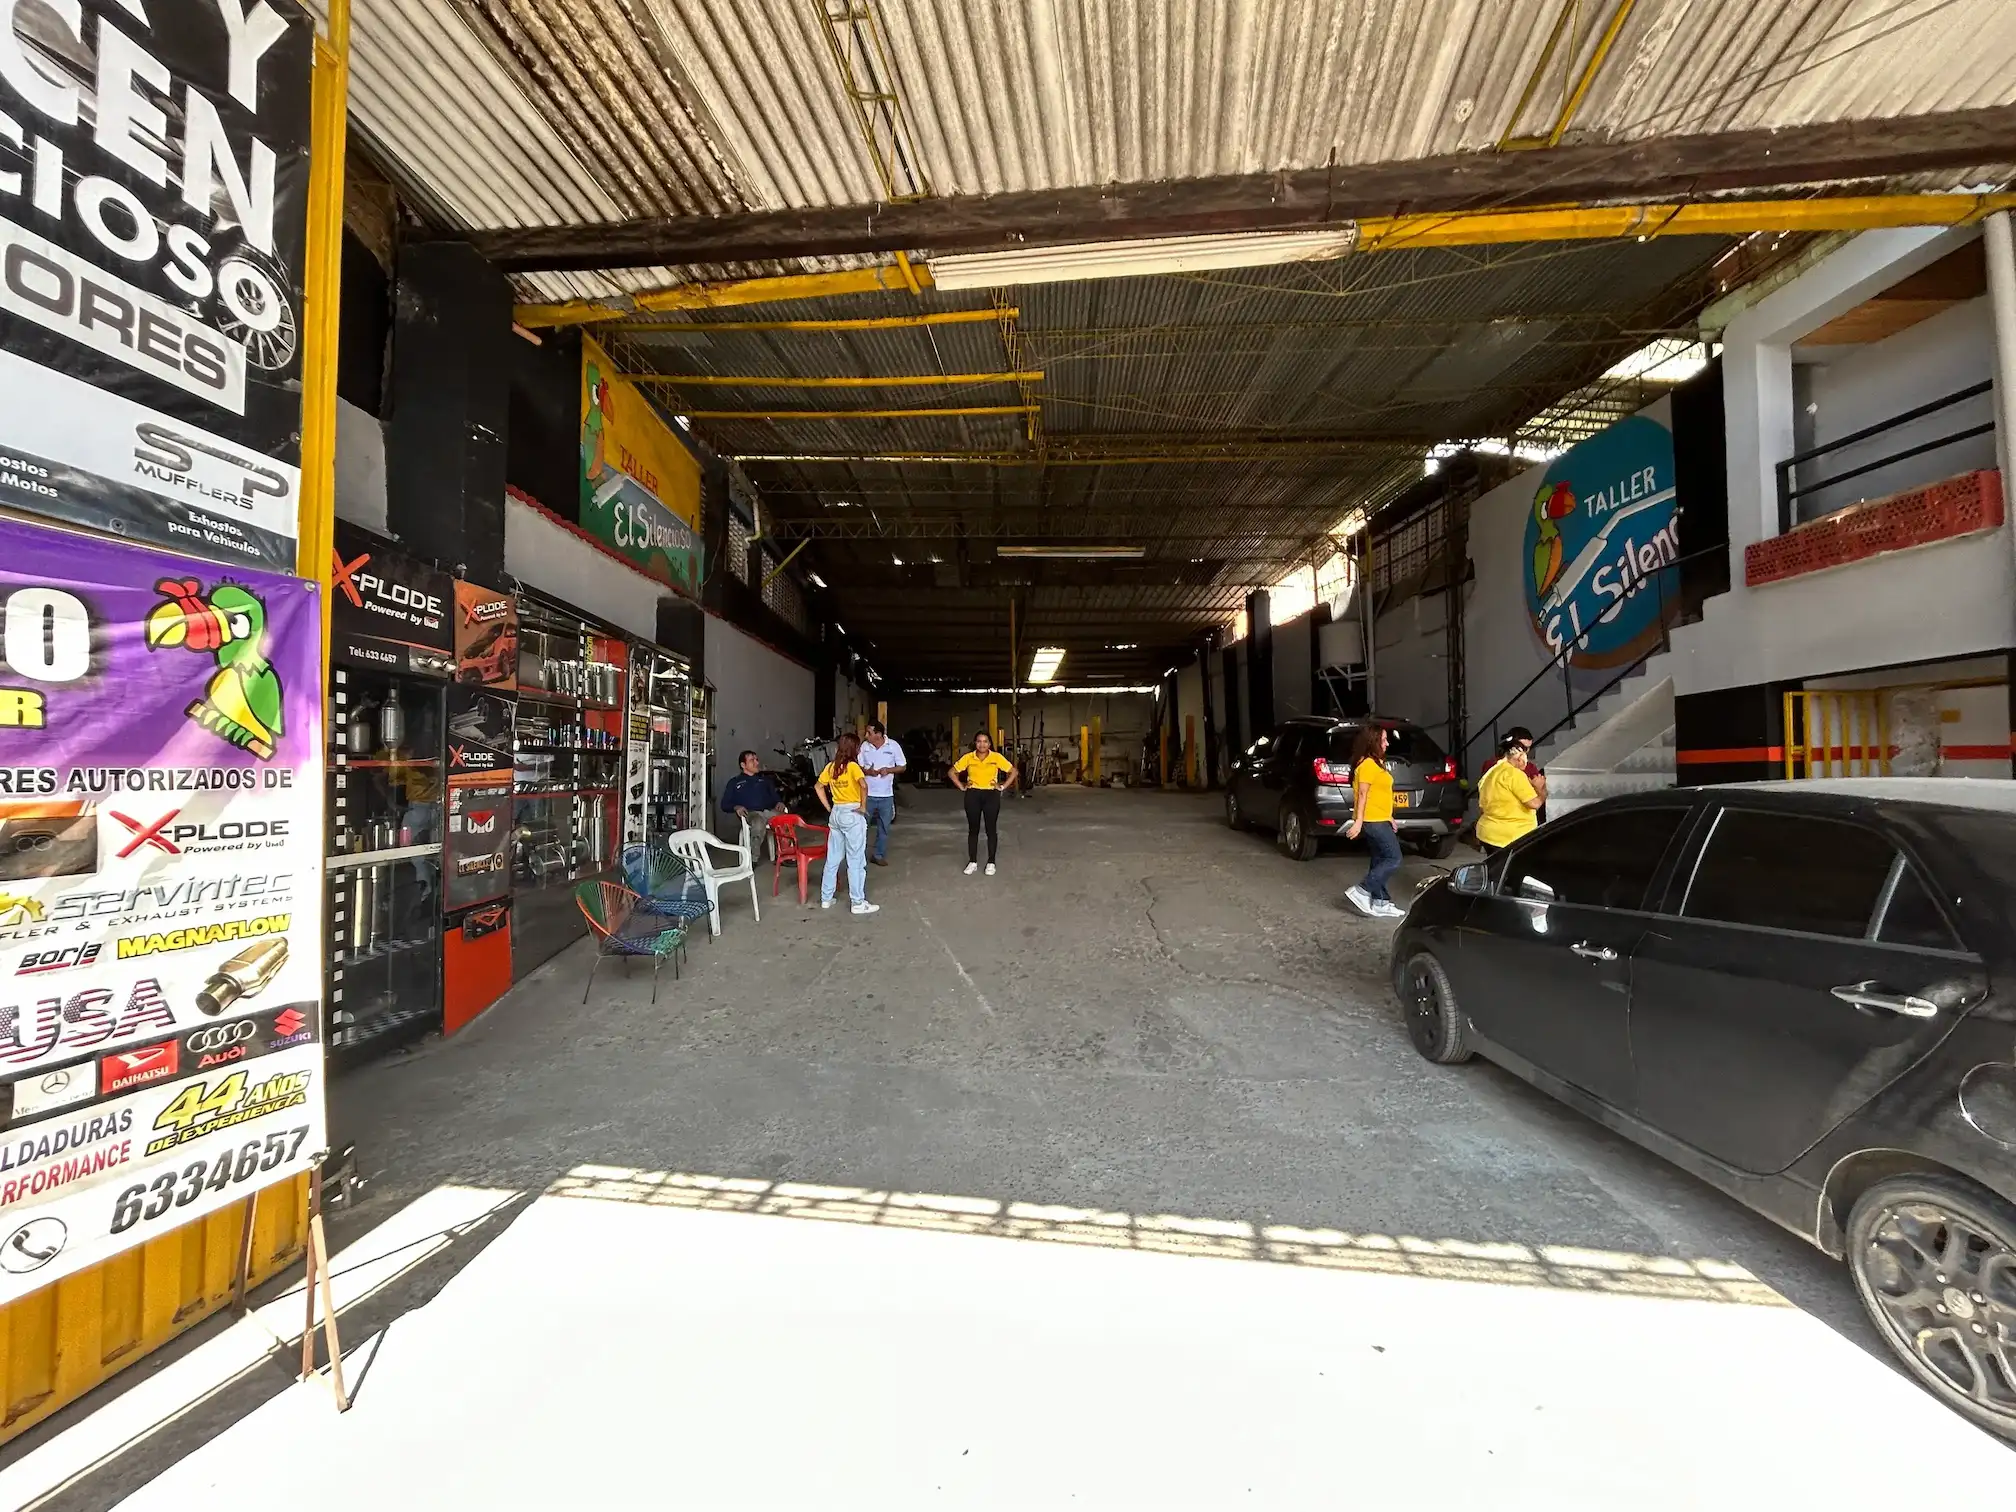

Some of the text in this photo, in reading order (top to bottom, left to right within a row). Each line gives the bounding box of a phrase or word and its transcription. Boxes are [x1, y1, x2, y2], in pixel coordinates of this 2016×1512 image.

[5, 243, 228, 390] ORES
[0, 471, 59, 498] Motos
[134, 461, 254, 510] MUFFLERS
[620, 444, 658, 498] TALLER
[1584, 466, 1657, 518] TALLER
[168, 521, 201, 538] para
[188, 511, 243, 537] Exhostos
[614, 501, 633, 548] El
[364, 600, 408, 620] Powered
[410, 613, 422, 626] by
[460, 599, 508, 625] X-PLODE
[349, 645, 397, 664] Tel: 633 4657
[448, 744, 495, 768] X-PLODE
[67, 767, 257, 793] AUTORIZADOS
[263, 769, 293, 790] DE
[109, 808, 290, 858] X-PLODE
[184, 843, 244, 854] Powered
[247, 842, 262, 851] by
[75, 921, 91, 931] &
[108, 906, 203, 928] EXHAUST
[214, 895, 293, 912] SYSTEMS
[117, 913, 292, 960] MAGNAFLOW
[270, 1031, 312, 1049] SUZUKI
[198, 1045, 247, 1069] Audi
[112, 1066, 170, 1090] DAIHATSU
[152, 1069, 249, 1132] 44
[242, 1069, 312, 1108] AÑOS
[144, 1091, 307, 1157] DE EXPERIENCIA
[0, 1108, 133, 1172] LDADURAS
[110, 1124, 310, 1235] 6334657
